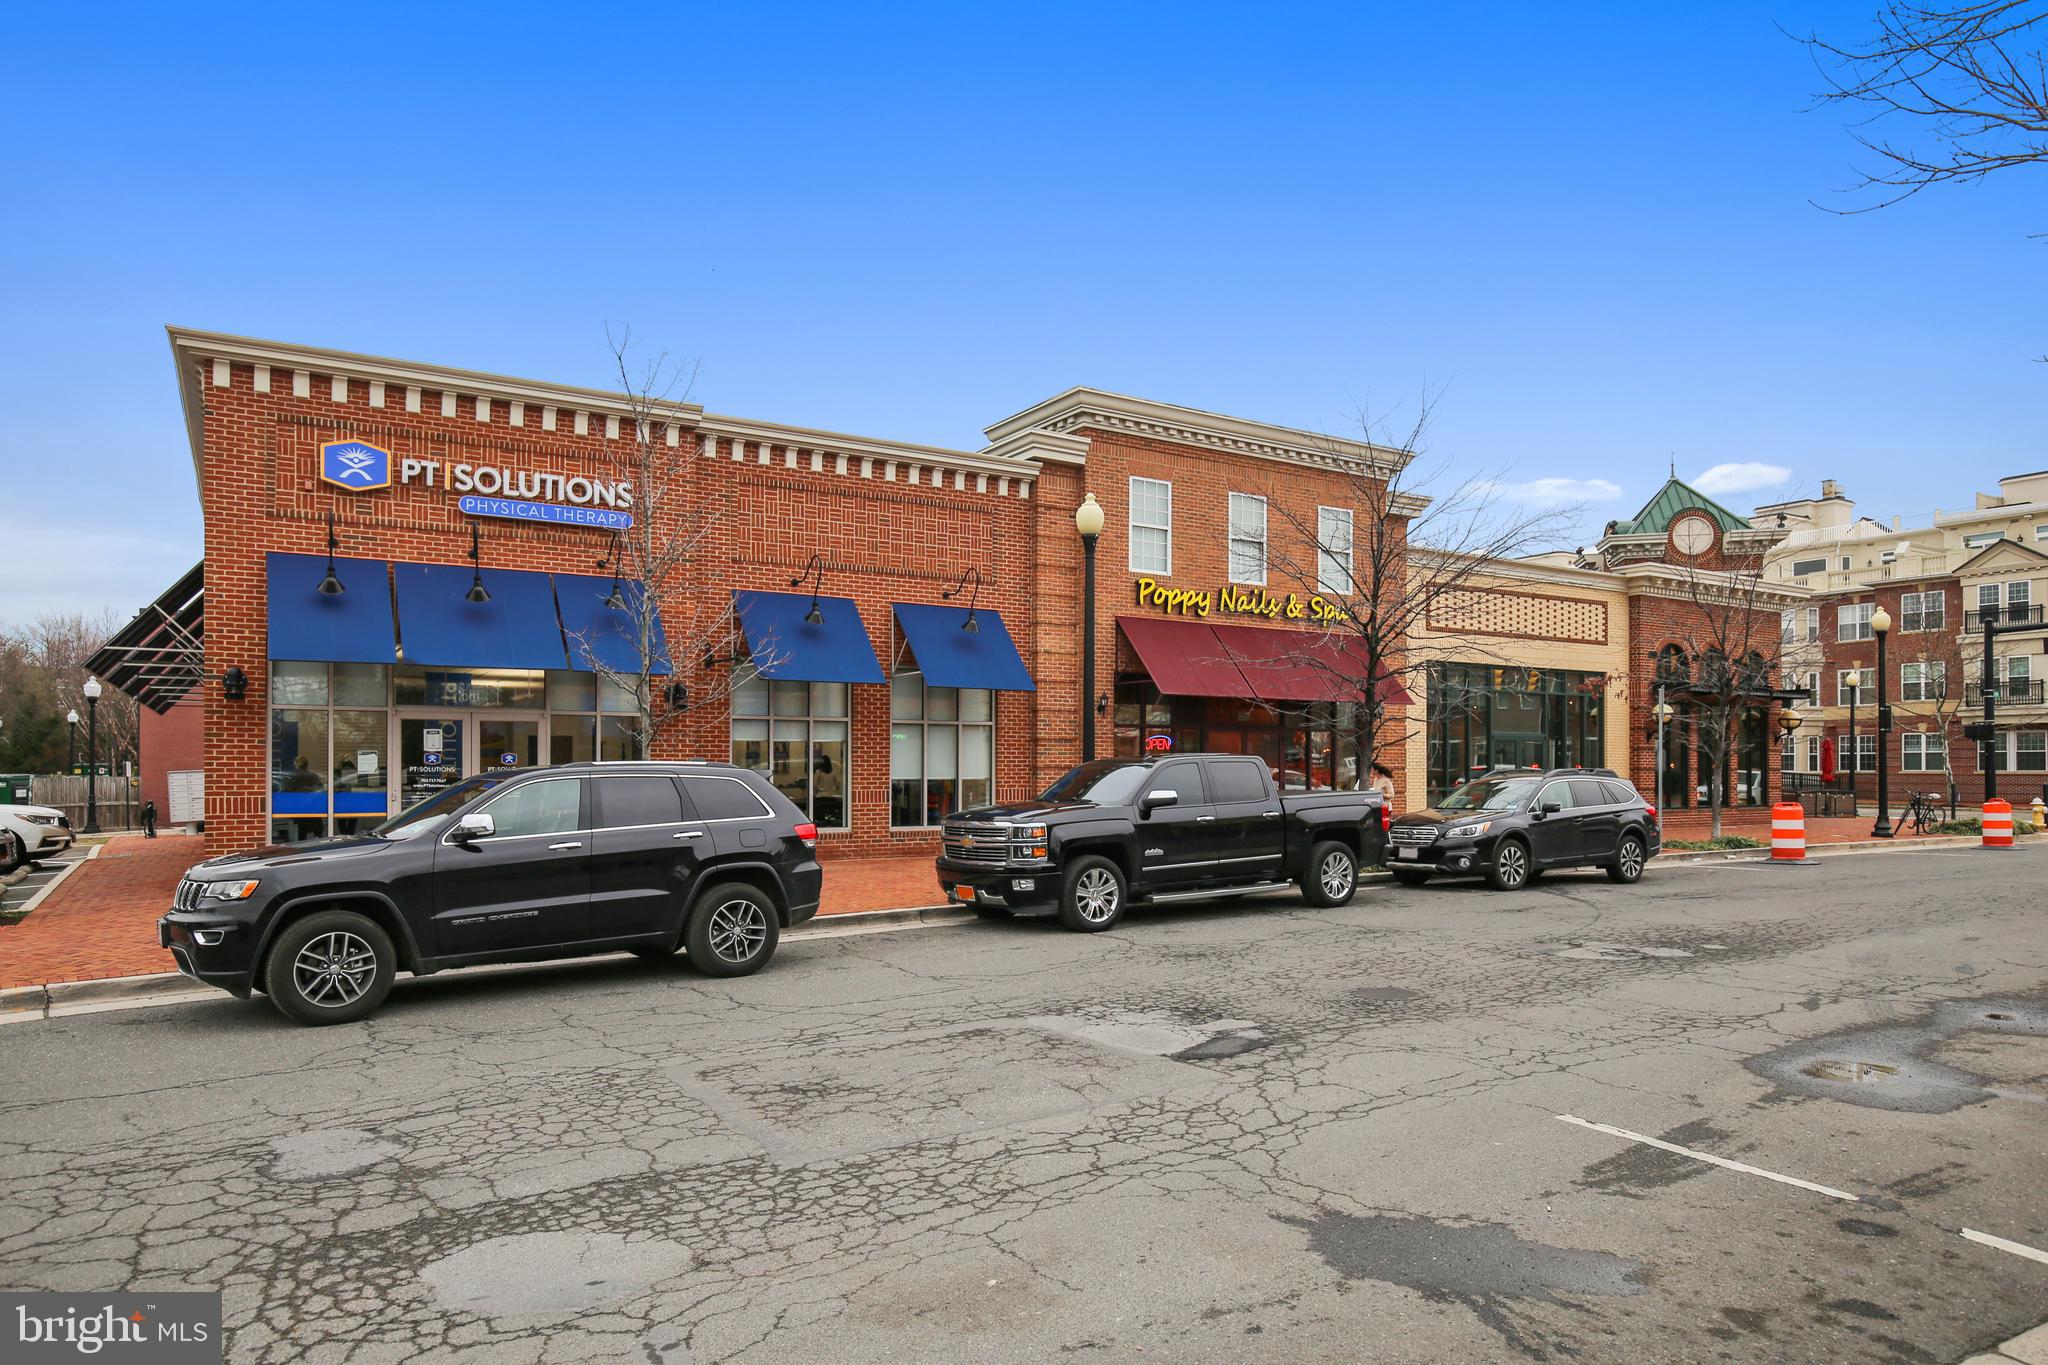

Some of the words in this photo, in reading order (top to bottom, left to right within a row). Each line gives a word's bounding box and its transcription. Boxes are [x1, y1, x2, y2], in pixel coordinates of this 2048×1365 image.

[401, 458, 439, 487] PT
[454, 463, 634, 508] SOLUTIONS
[465, 499, 548, 519] PHYSICAL
[554, 507, 629, 526] THERAPY
[1136, 577, 1212, 617] Poppy
[1218, 585, 1283, 618] Nails
[1286, 593, 1304, 618] &
[1145, 738, 1170, 750] OPEN
